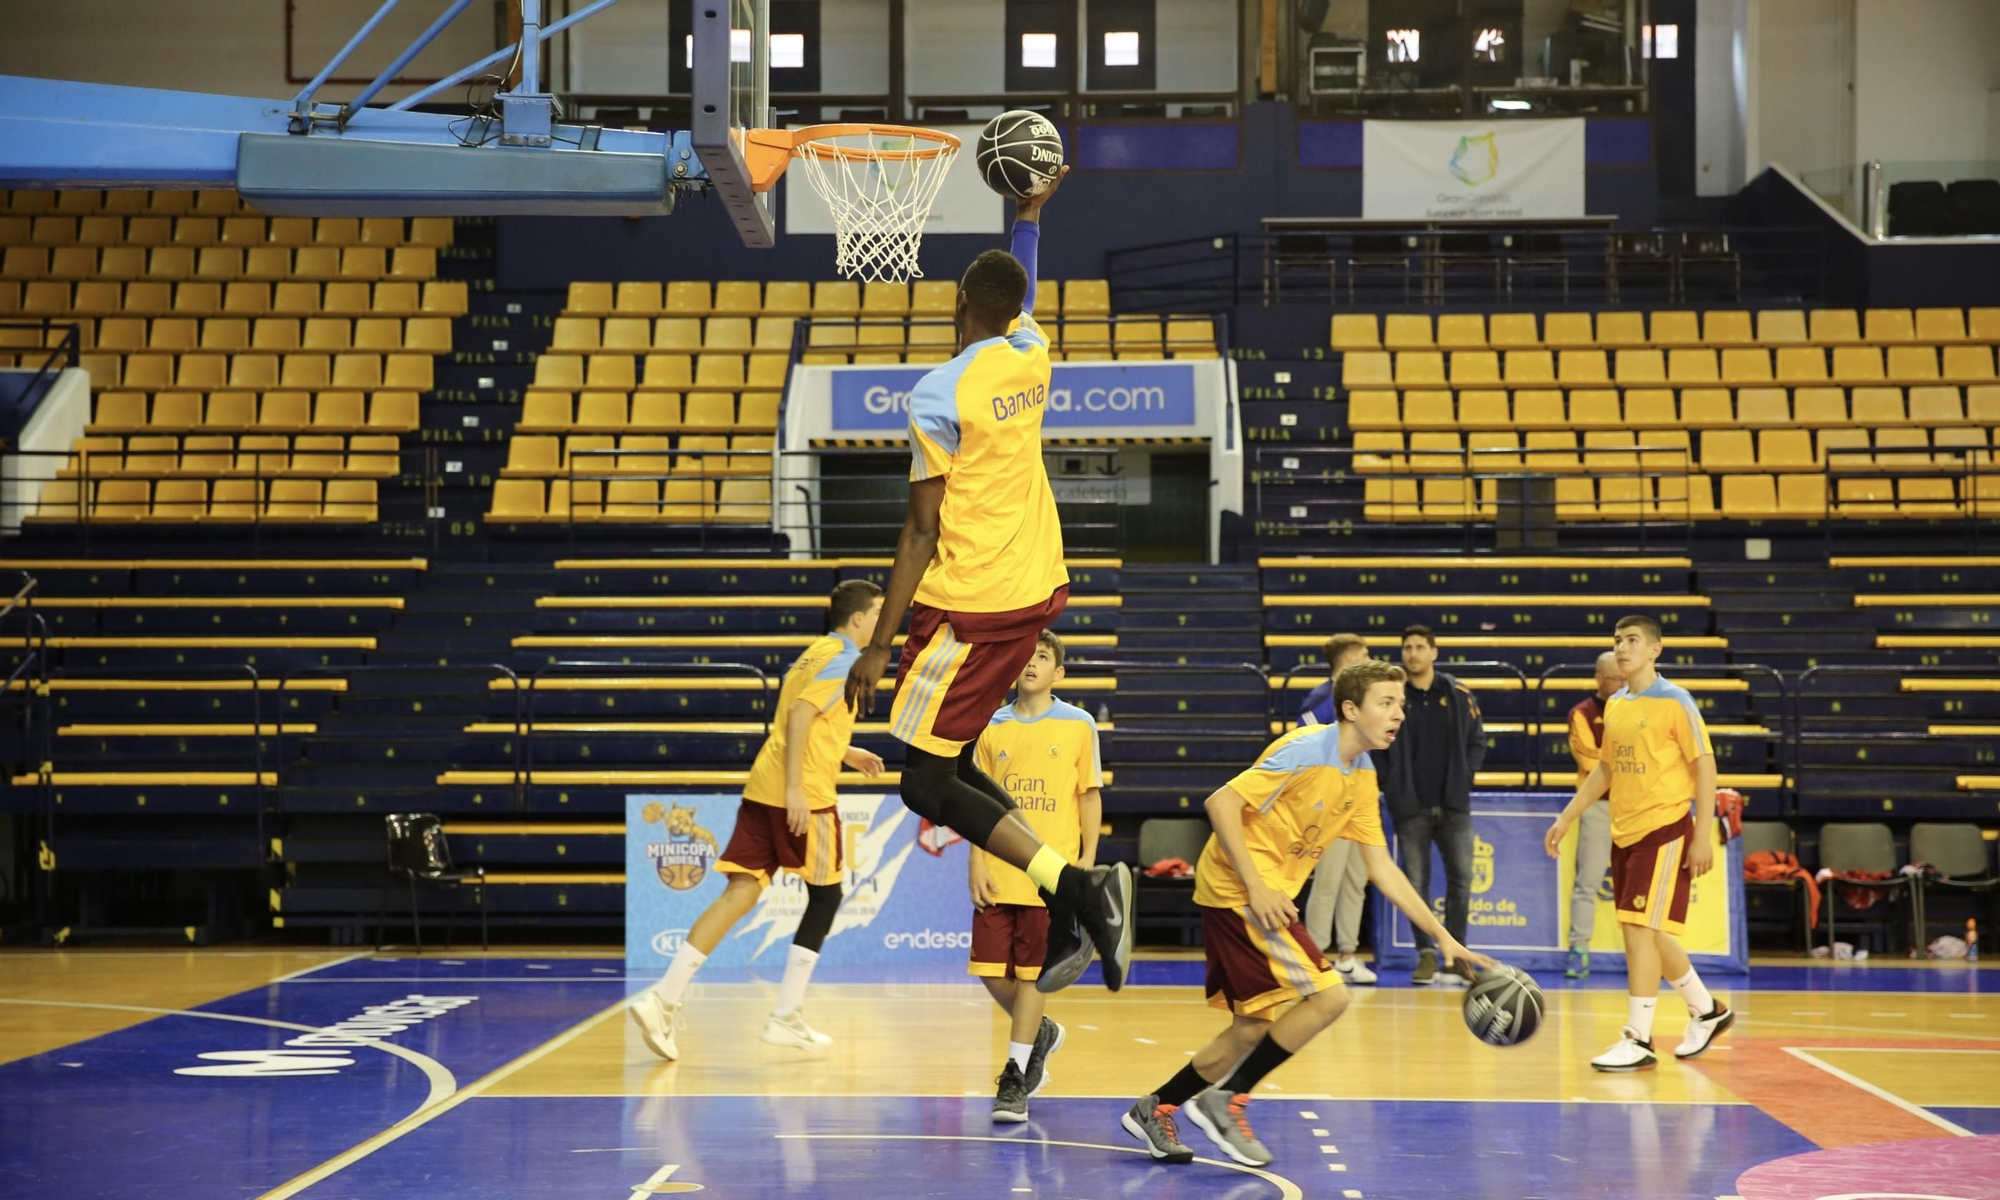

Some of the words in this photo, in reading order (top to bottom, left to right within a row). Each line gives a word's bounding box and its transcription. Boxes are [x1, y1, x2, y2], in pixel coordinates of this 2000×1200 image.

[455, 353, 495, 363] FILA
[1227, 349, 1266, 360] FILA
[1303, 349, 1324, 359] 13
[499, 391, 519, 402] 12
[1244, 387, 1285, 398] FILA
[1313, 387, 1336, 400] 12
[992, 384, 1045, 422] Bankia
[422, 430, 463, 441] FILA
[484, 430, 503, 441] 11
[1248, 428, 1290, 440] FILA
[1319, 428, 1339, 440] 11
[468, 475, 491, 486] 10
[451, 522, 475, 535] 09
[1004, 773, 1045, 792] Gran
[1015, 791, 1056, 812] naria
[647, 843, 716, 858] MINICOPA
[662, 856, 702, 868] ENDESA
[1496, 898, 1516, 912] de
[1467, 912, 1527, 927] Canaria
[884, 928, 973, 950] endesa
